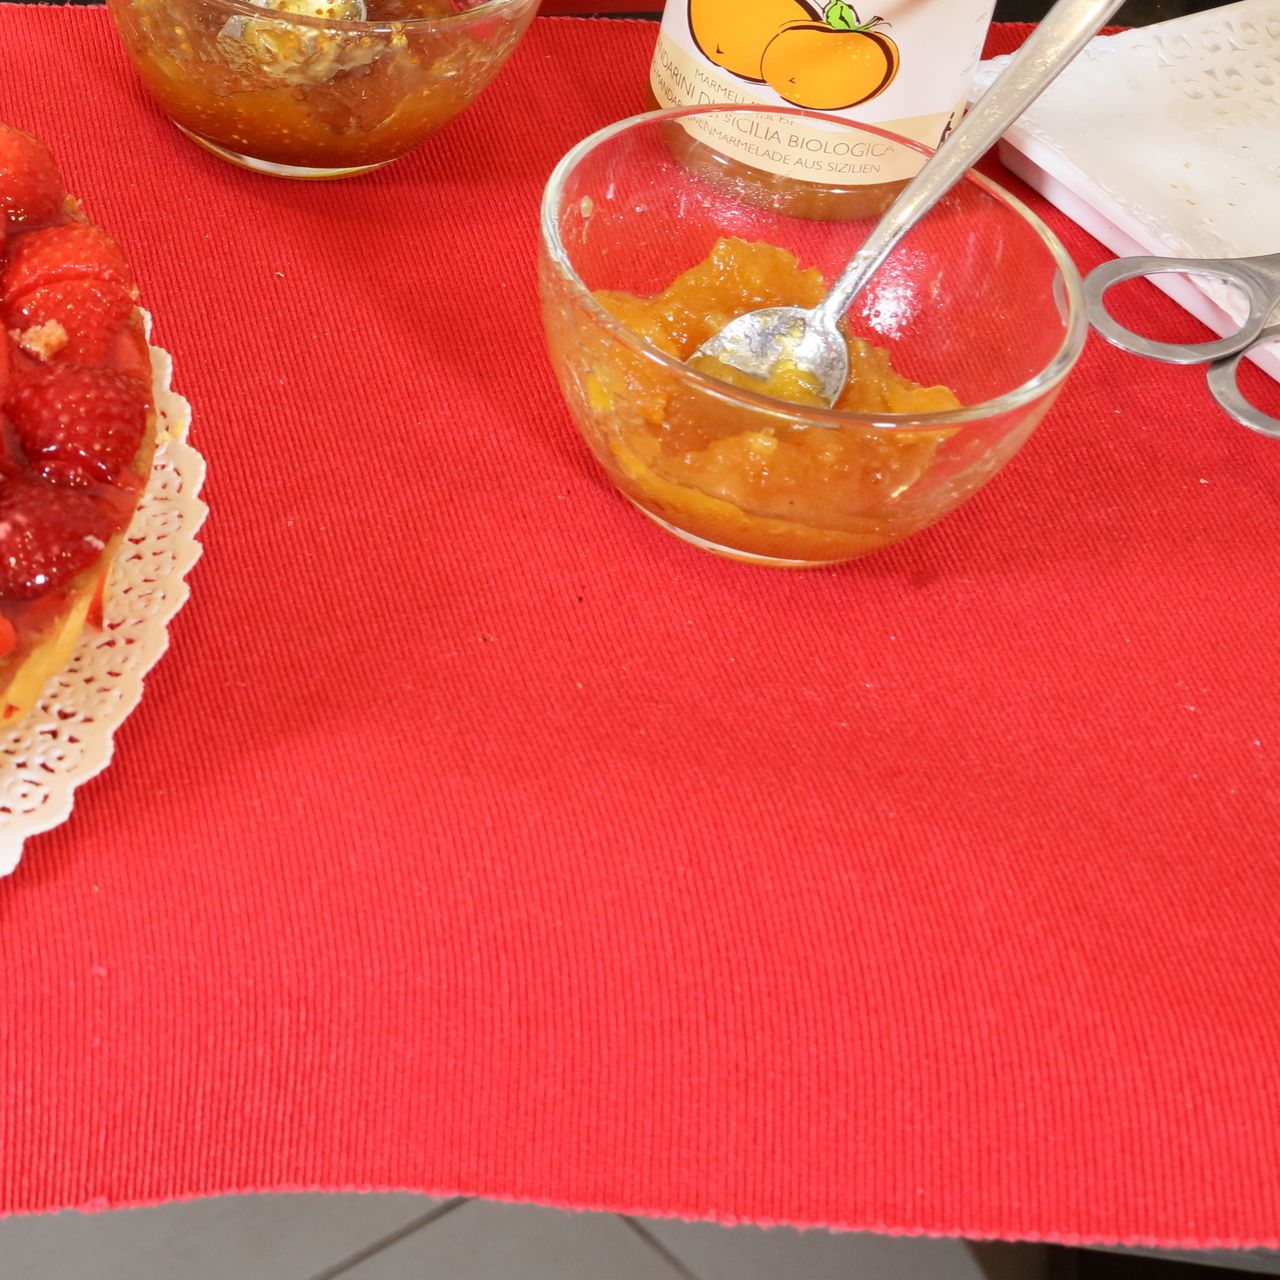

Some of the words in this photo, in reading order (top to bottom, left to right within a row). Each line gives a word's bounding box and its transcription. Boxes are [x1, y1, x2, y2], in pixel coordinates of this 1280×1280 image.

[722, 112, 782, 144] SICILIA
[788, 134, 897, 158] BIOLOGICA
[793, 158, 823, 172] AUS
[827, 161, 882, 175] SIZILIEN
